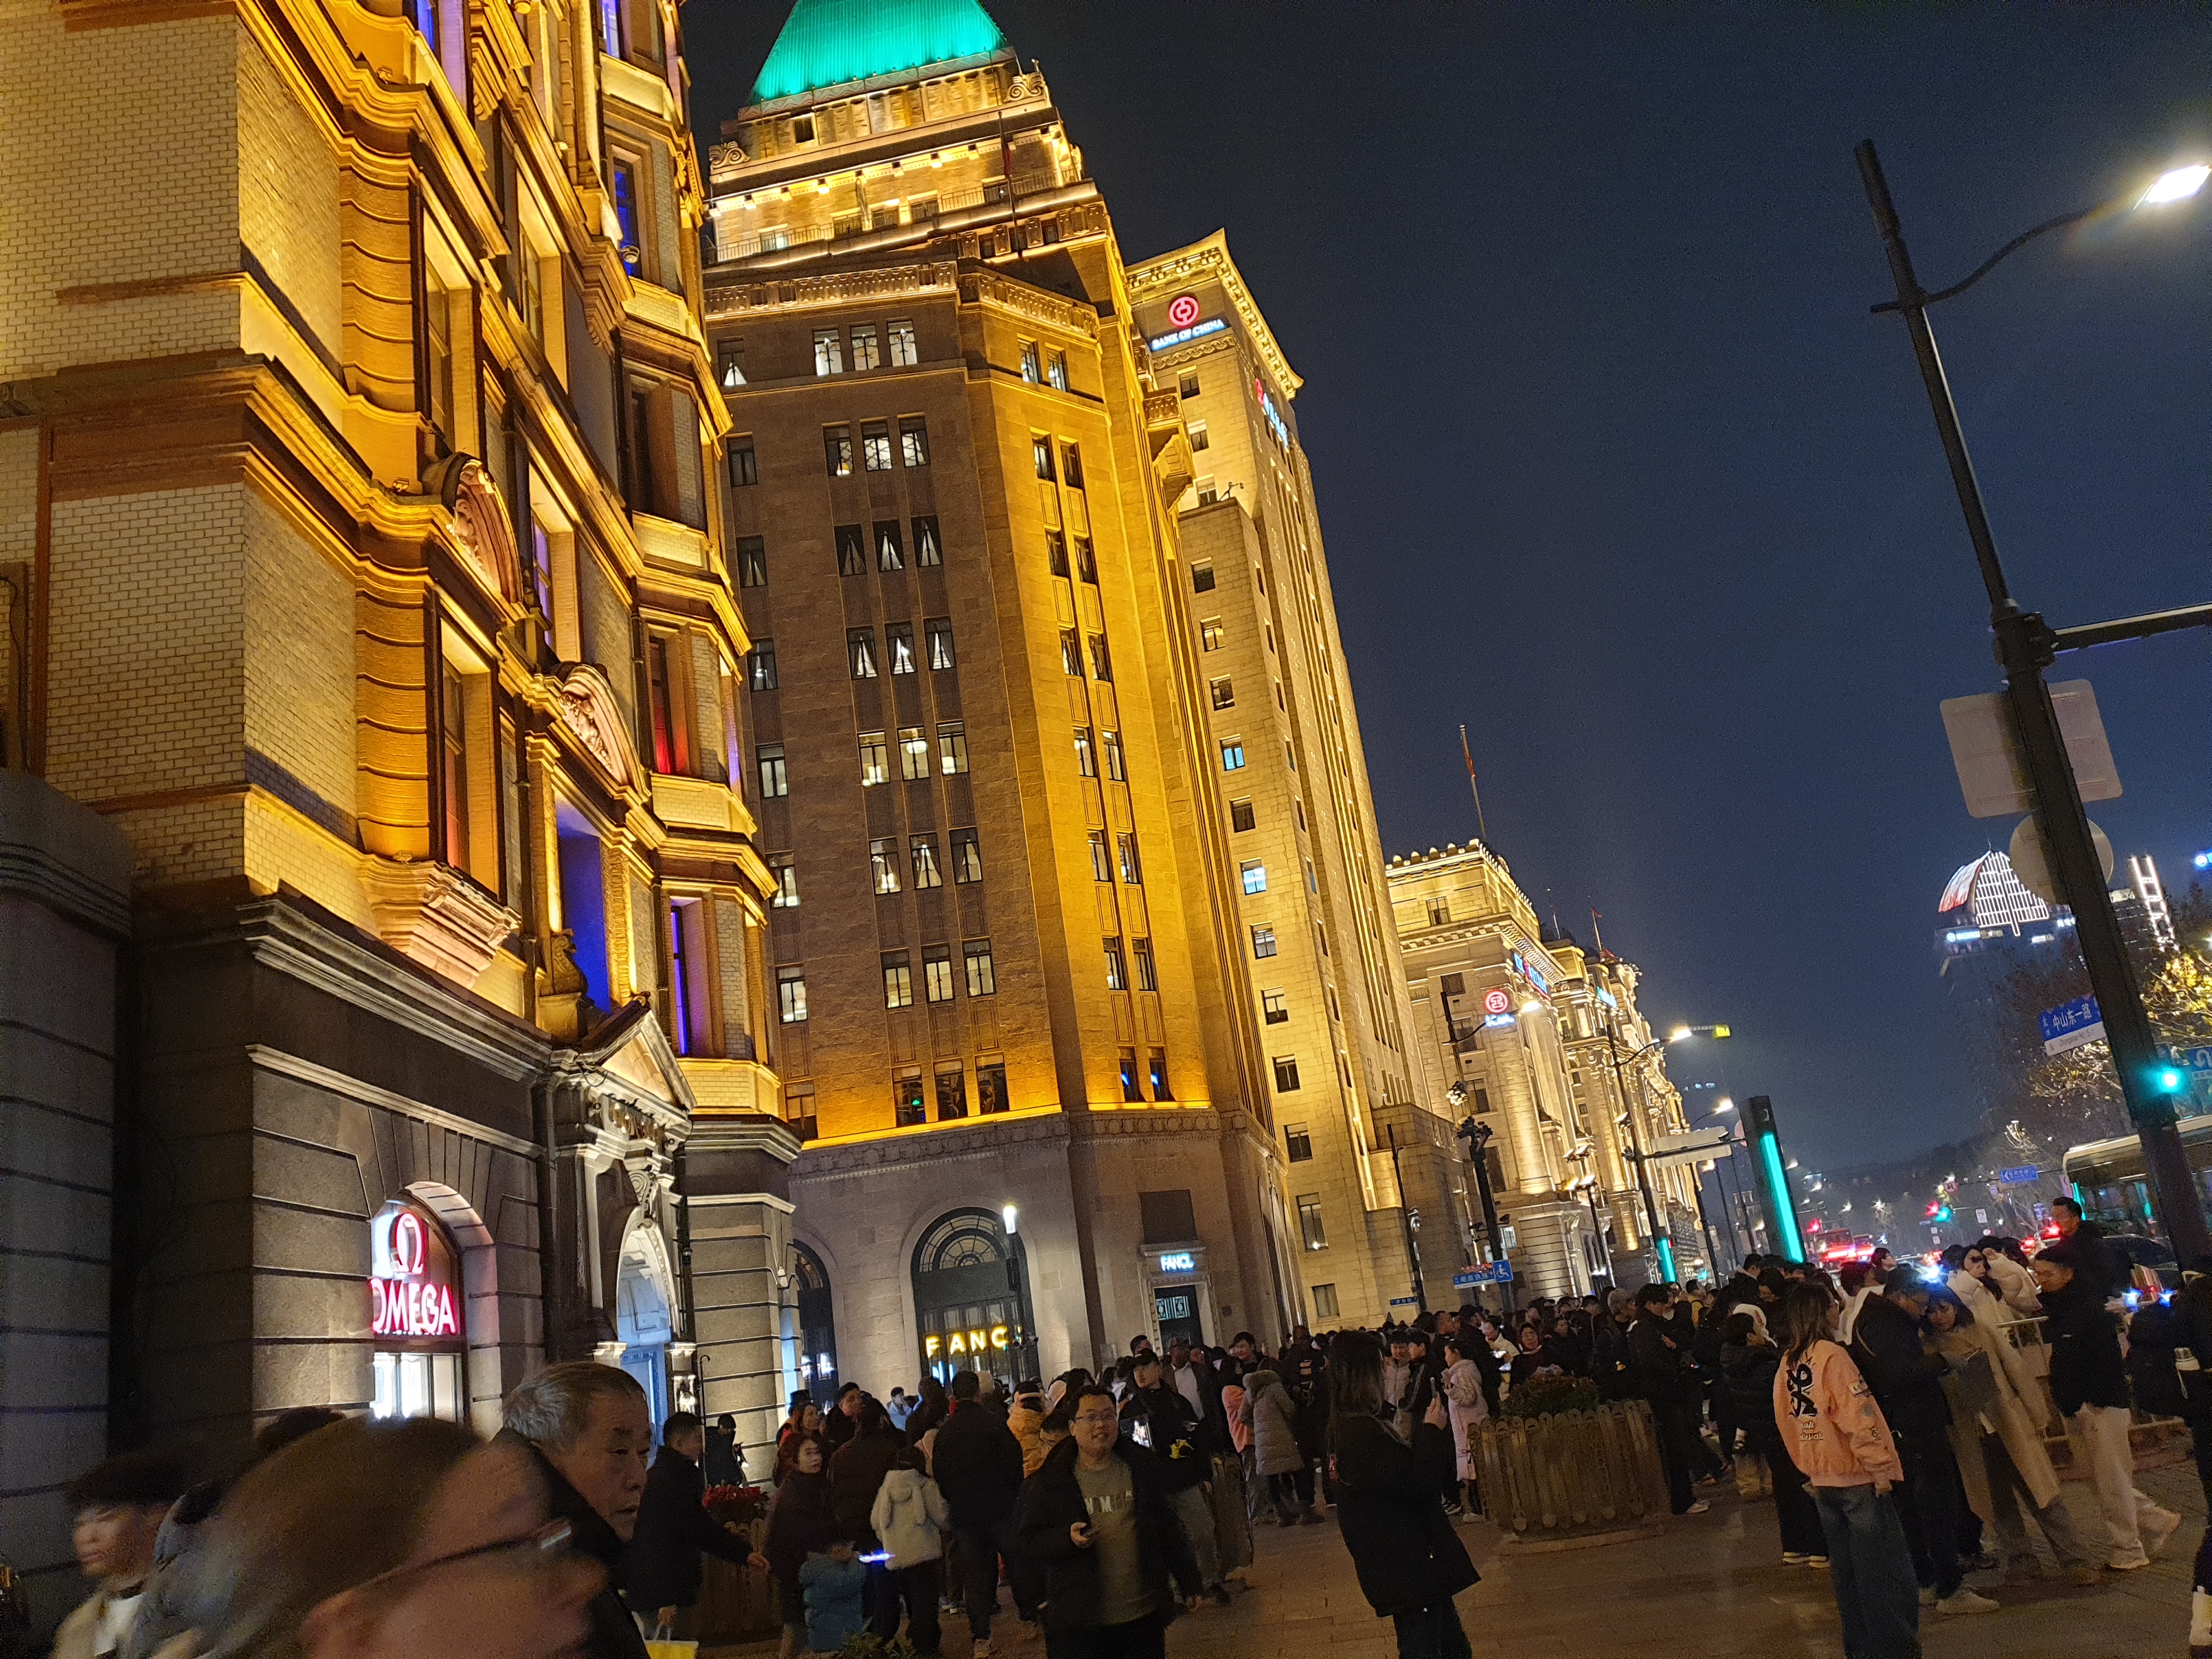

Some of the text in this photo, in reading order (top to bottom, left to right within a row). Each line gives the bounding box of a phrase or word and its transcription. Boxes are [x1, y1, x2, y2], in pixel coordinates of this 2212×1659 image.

[1152, 319, 1224, 349] BANK OF CHINA
[2052, 1002, 2092, 1031] 中山东一路
[1160, 1252, 1195, 1272] FANCL
[370, 1278, 456, 1334] OMEGA
